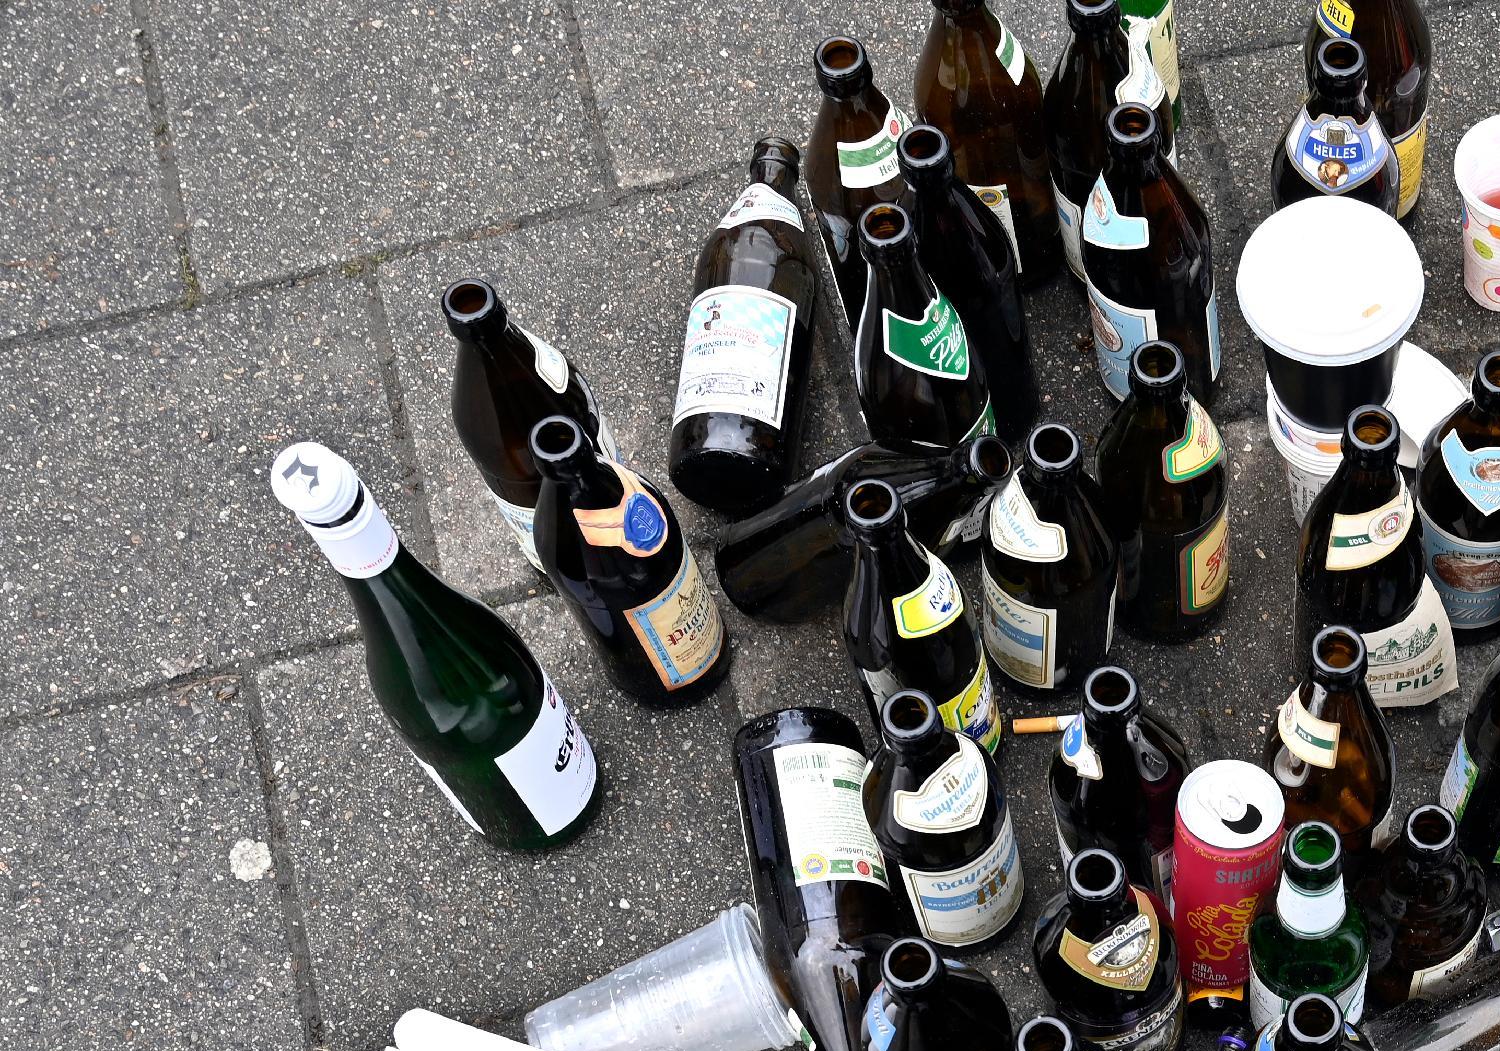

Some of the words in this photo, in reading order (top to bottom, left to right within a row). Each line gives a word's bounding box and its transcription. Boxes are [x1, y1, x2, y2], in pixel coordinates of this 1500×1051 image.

[1327, 1, 1347, 27] HELL
[1313, 143, 1357, 160] HELLES
[929, 320, 964, 372] Pils
[1348, 538, 1368, 546] EDEL
[919, 763, 980, 822] Bayreuther
[1187, 903, 1221, 936] Piña
[1195, 892, 1258, 962] Colada
[1192, 961, 1213, 974] PIÑA
[1192, 970, 1228, 982] COLADA
